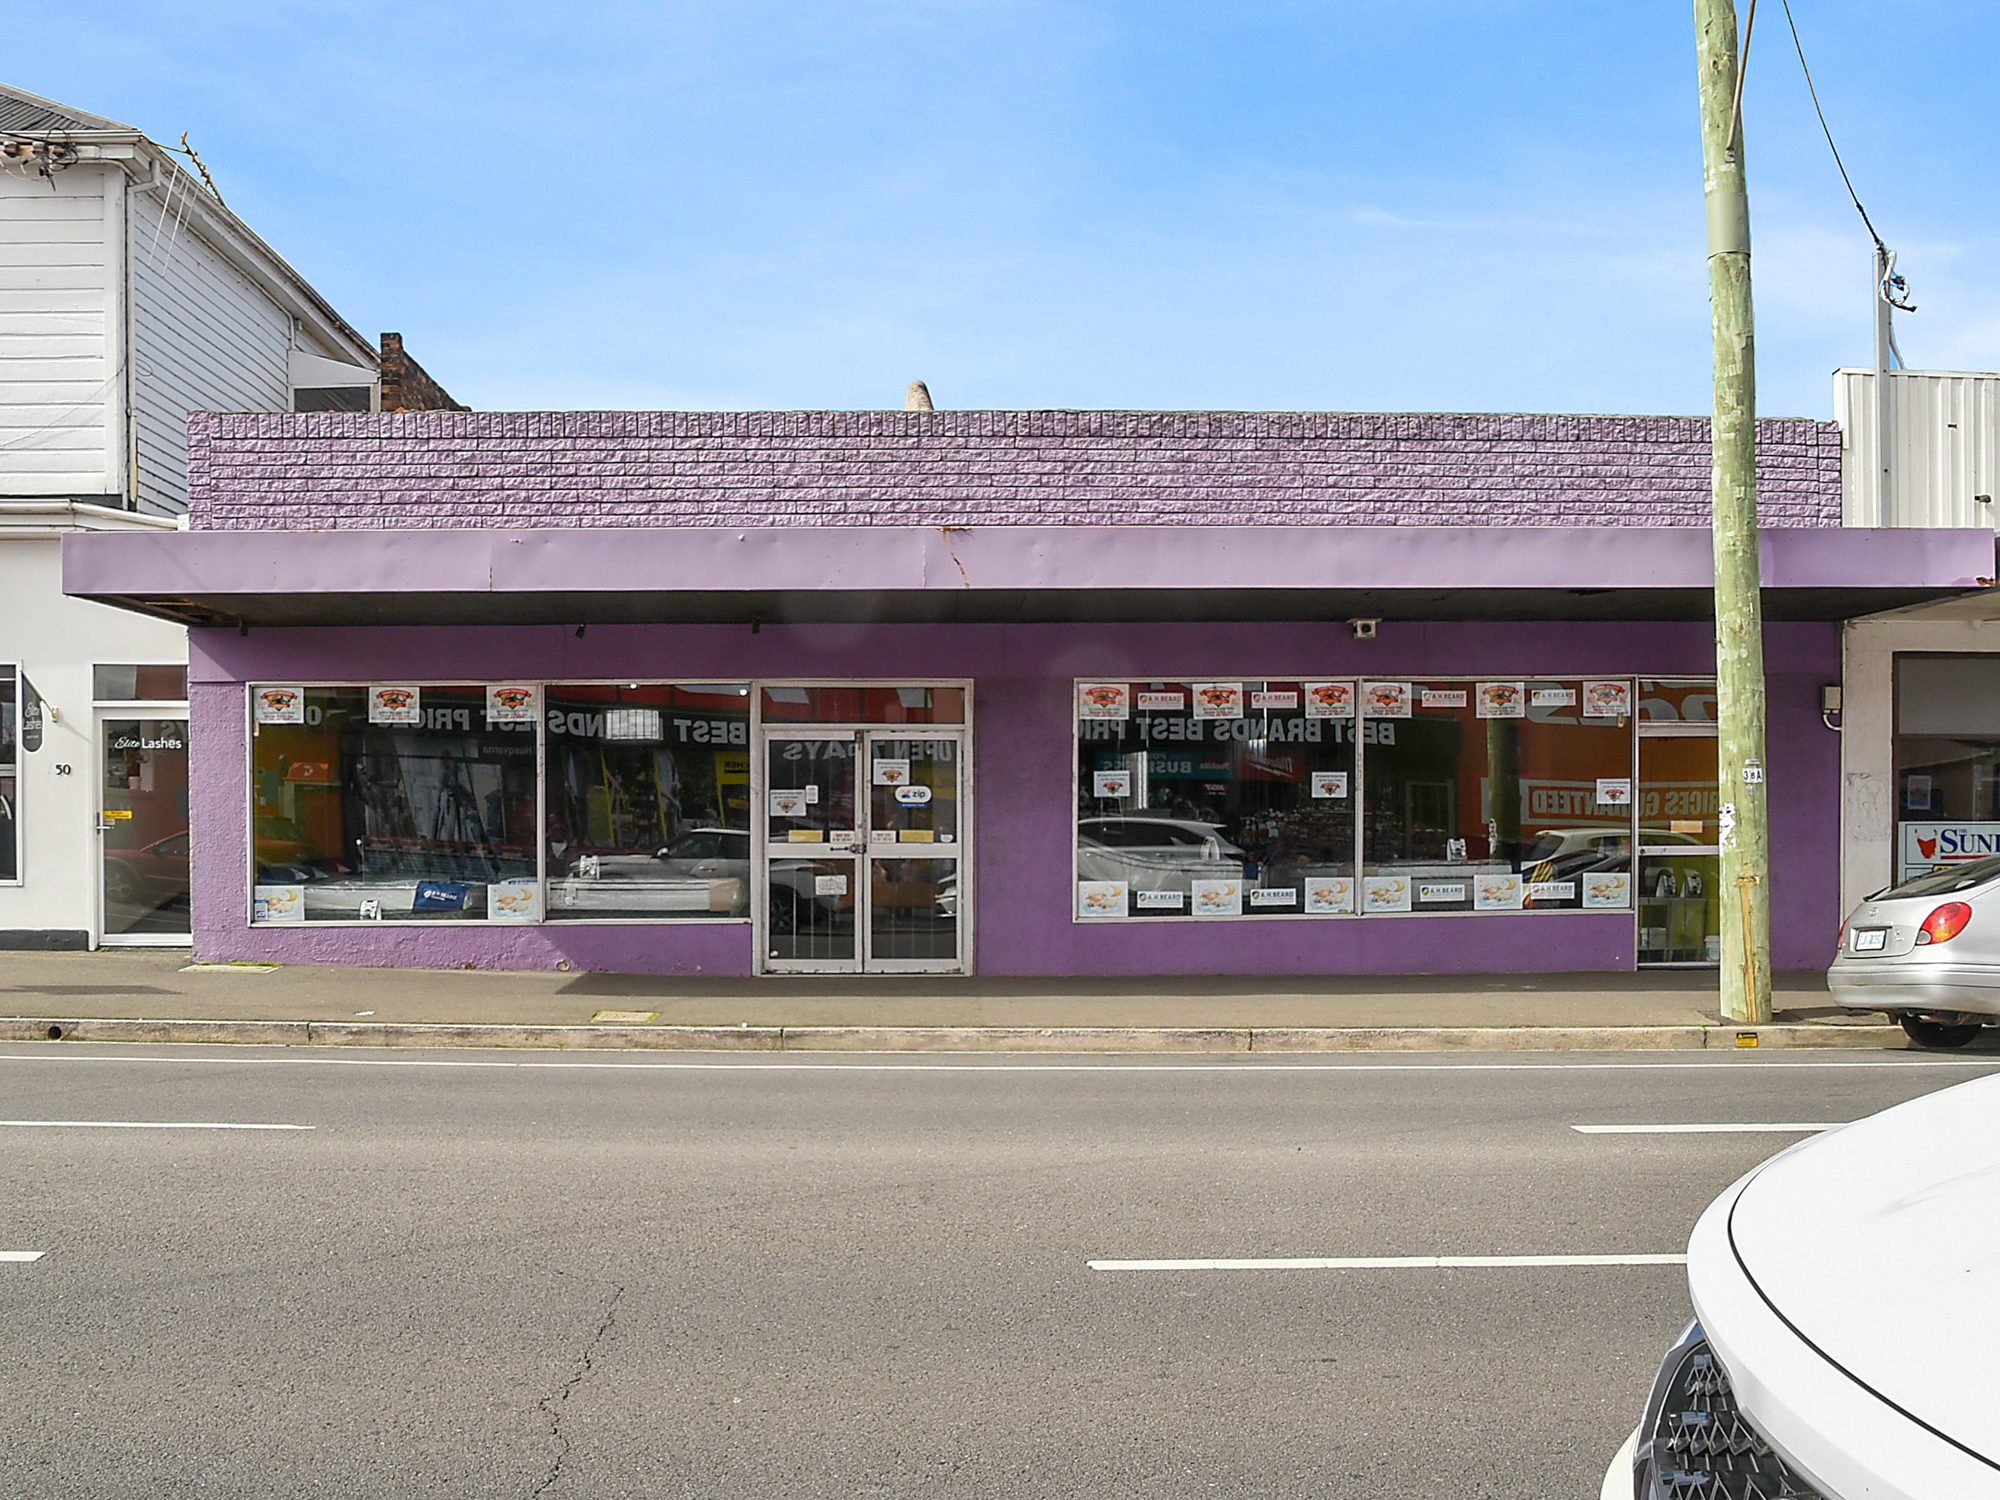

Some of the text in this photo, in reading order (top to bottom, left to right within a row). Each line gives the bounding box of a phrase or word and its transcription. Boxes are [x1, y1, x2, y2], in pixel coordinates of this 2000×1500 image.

[114, 737, 182, 749] Elite Lashes
[55, 764, 71, 775] 50
[912, 790, 926, 799] zip
